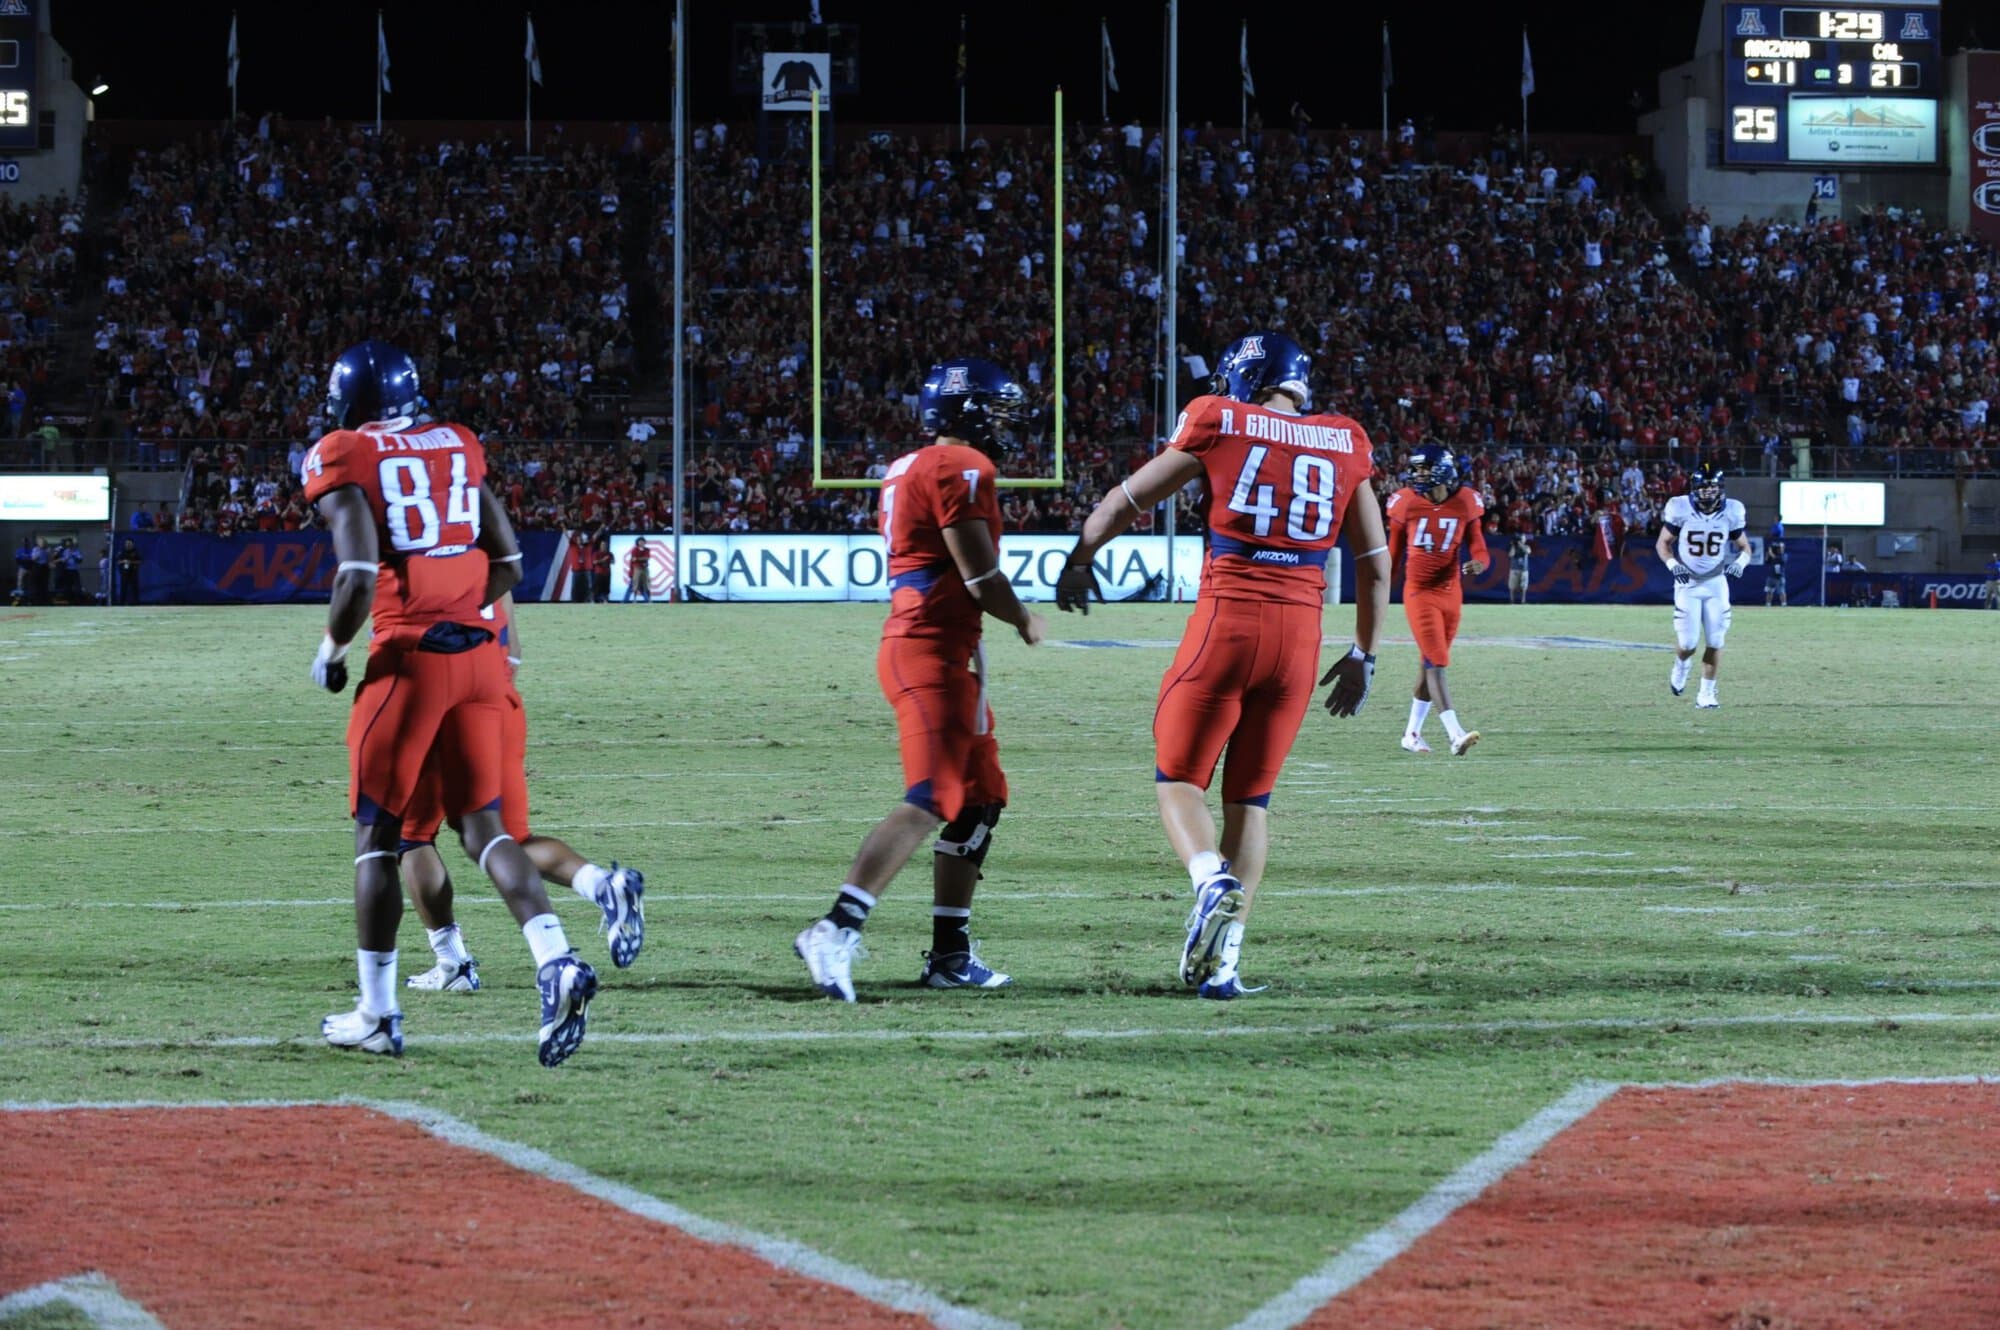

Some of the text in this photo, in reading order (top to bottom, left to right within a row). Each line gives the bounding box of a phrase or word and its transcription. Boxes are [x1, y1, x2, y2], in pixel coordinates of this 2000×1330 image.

[1819, 11, 1882, 39] 1:29
[1872, 43, 1903, 61] CAL
[1764, 61, 1796, 85] 41
[1870, 64, 1902, 87] 27
[1733, 106, 1777, 141] 25
[1814, 180, 1835, 196] 14
[1238, 336, 1265, 360] A
[940, 367, 970, 395] A
[963, 469, 980, 503] 7
[1227, 445, 1335, 541] 48
[379, 452, 480, 551] 84
[1413, 517, 1458, 553] 47
[1687, 530, 1724, 557] 56
[688, 548, 833, 587] BANK
[1252, 550, 1299, 563] ARIZONA
